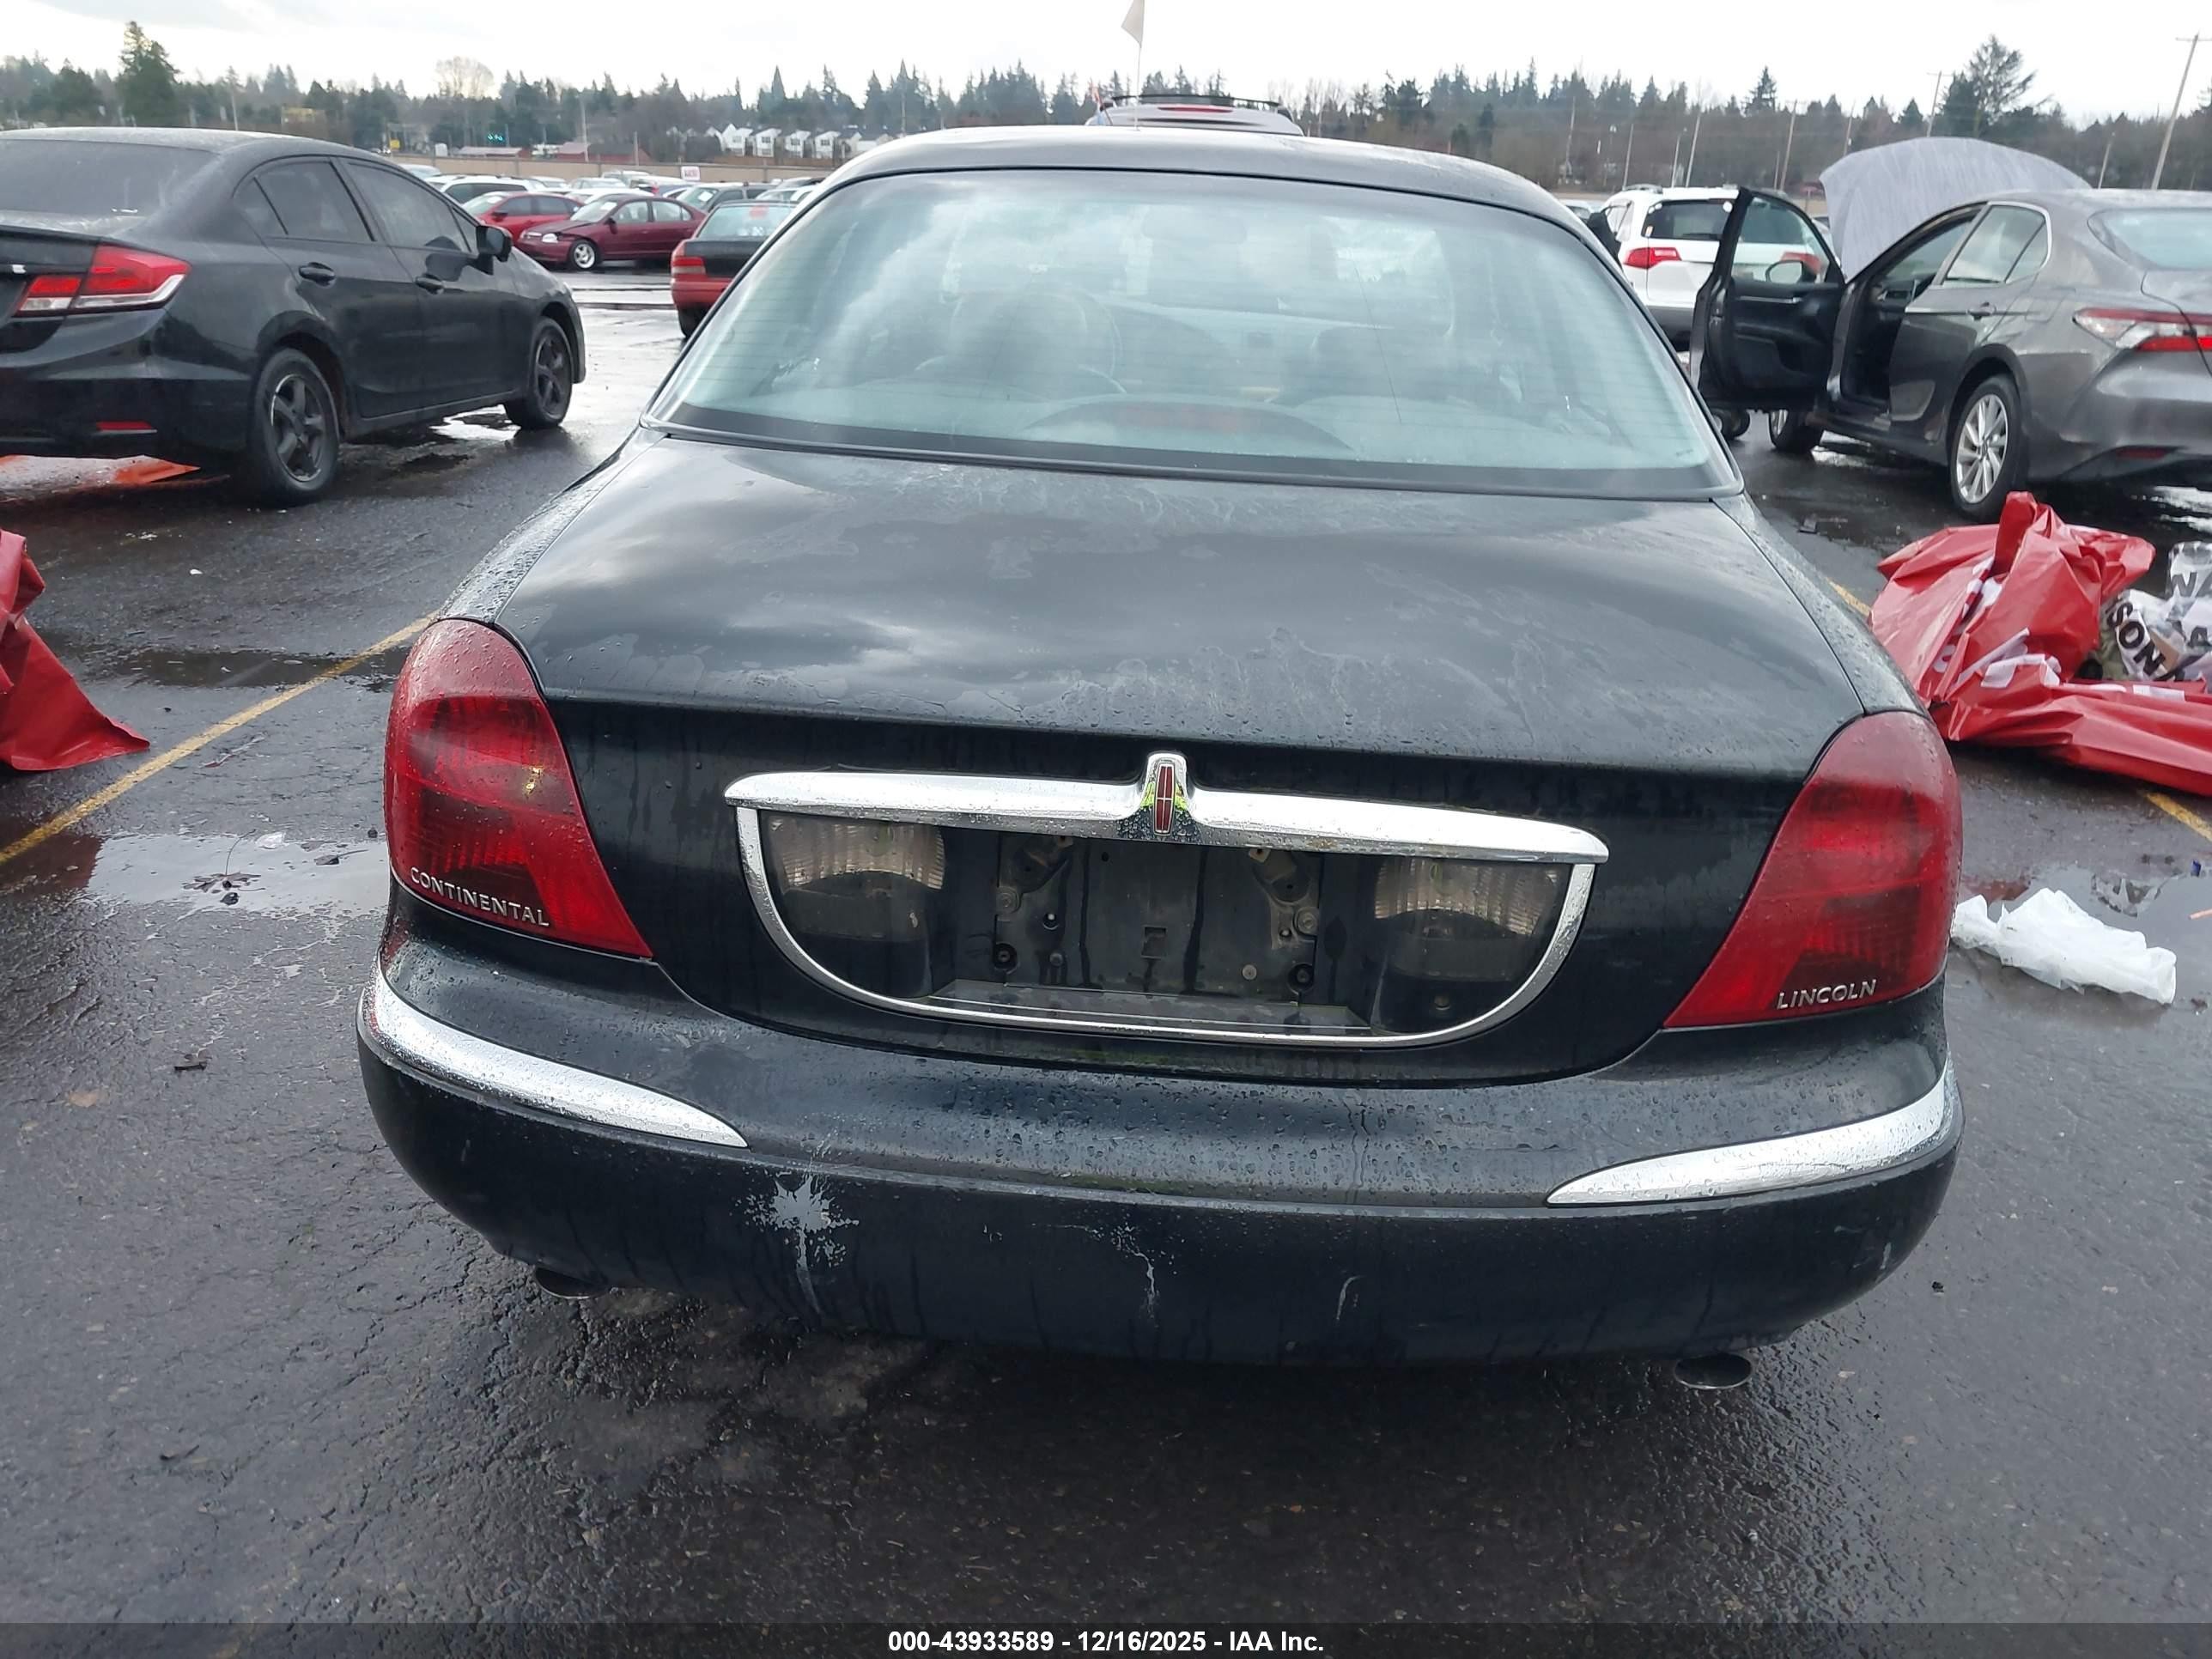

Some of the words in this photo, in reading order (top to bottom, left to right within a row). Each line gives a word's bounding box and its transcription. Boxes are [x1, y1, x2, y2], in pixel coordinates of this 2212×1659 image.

[2106, 599, 2185, 681] SON
[410, 866, 550, 927] CONTINENTAL
[1777, 978, 1877, 1010] LINCOLN
